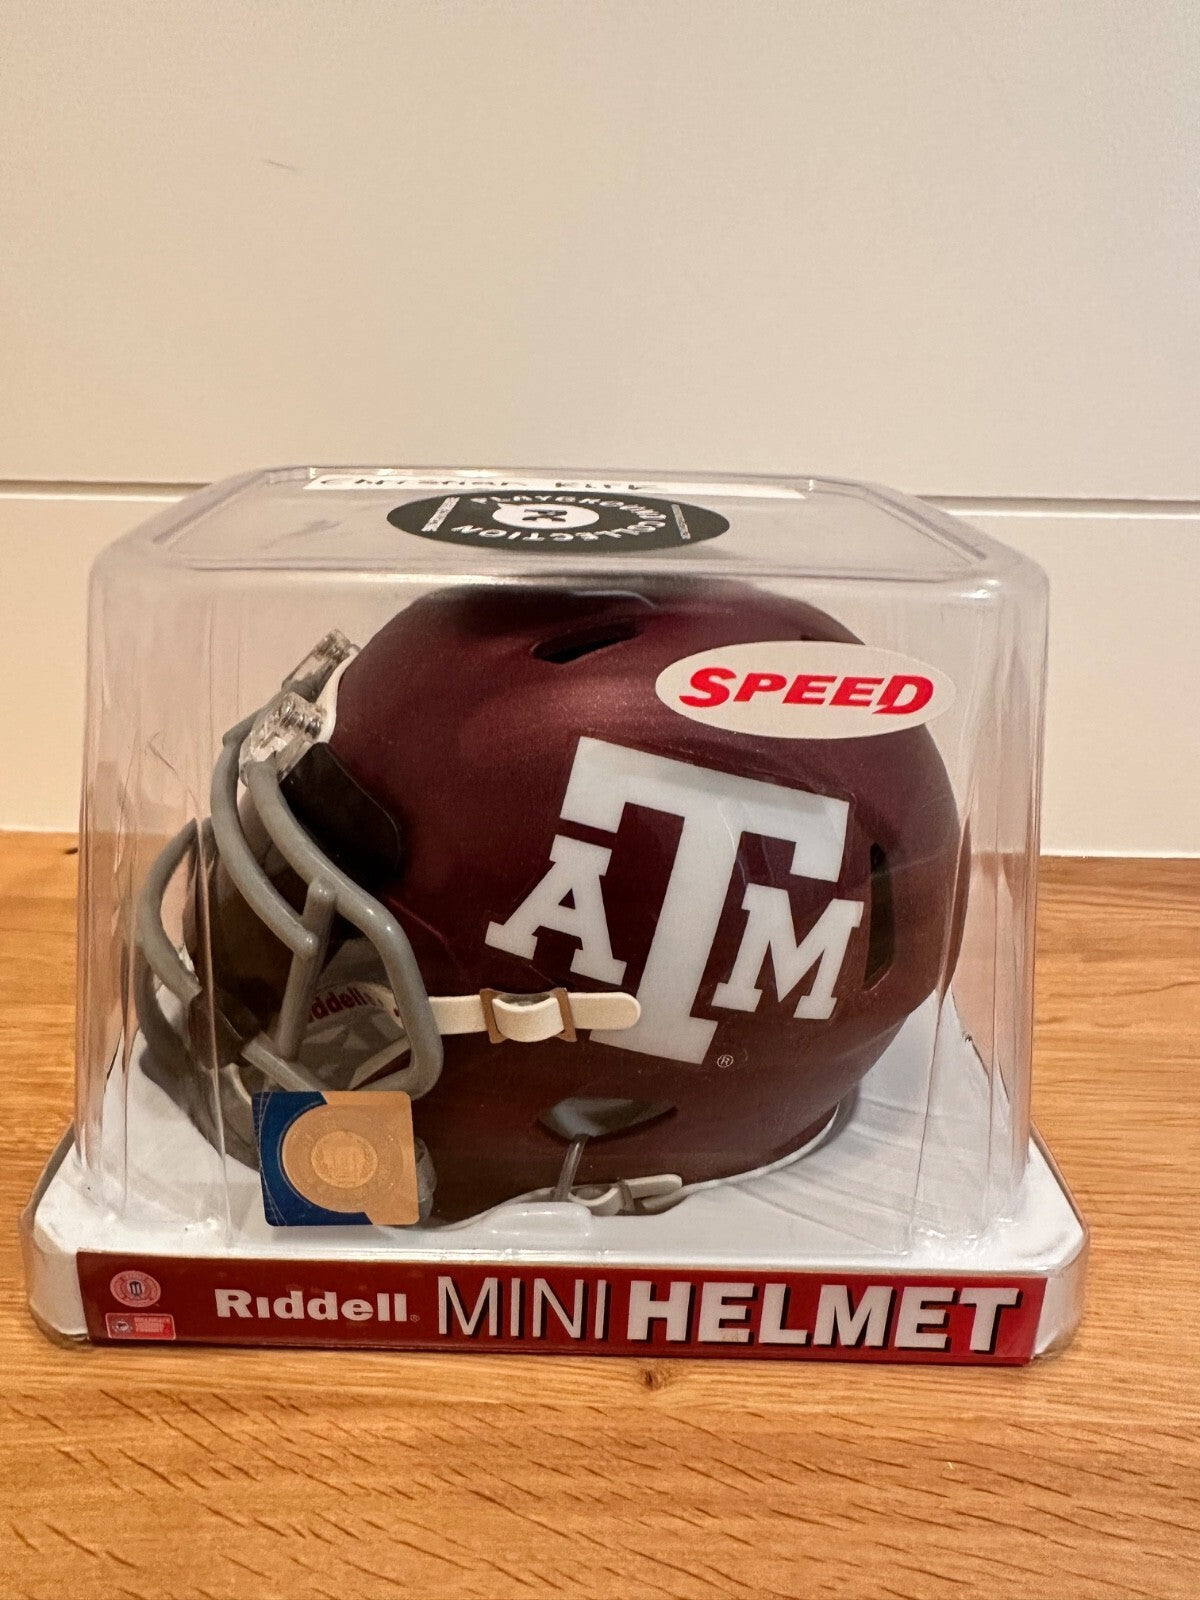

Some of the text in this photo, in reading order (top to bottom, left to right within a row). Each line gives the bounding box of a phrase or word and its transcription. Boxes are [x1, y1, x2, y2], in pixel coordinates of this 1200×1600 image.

[451, 520, 666, 542] COLLECTION
[678, 666, 934, 715] SPEED
[307, 986, 369, 1021] ddell
[214, 1288, 408, 1322] Riddell
[437, 1275, 606, 1338] MINI
[626, 1280, 1021, 1352] HELMET
